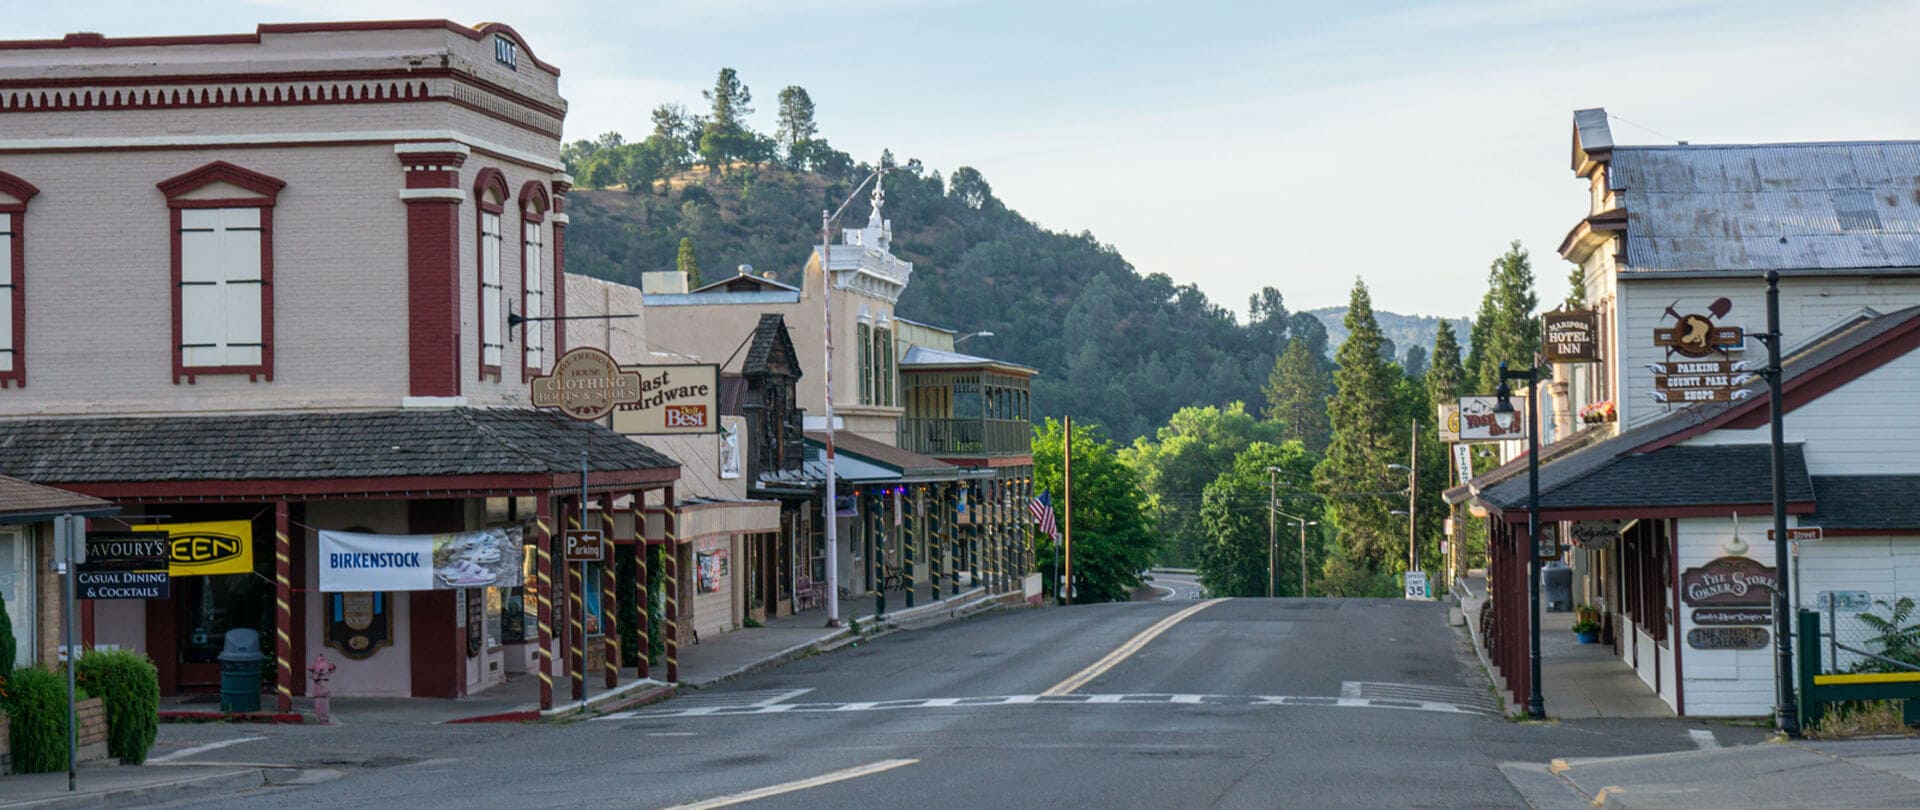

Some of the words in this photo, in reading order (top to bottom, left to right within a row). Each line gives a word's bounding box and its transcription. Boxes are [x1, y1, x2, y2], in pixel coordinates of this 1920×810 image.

[1549, 331, 1589, 342] HOTEL
[1558, 343, 1581, 354] INN
[1677, 363, 1720, 373] PARKING
[547, 377, 626, 391] CLOTHING
[642, 370, 670, 392] ast
[1667, 377, 1700, 387] COUNTY
[1705, 376, 1729, 386] PARK
[540, 391, 578, 402] BOOTS
[583, 392, 591, 401] &
[596, 389, 635, 400] SHOES
[1684, 390, 1715, 401] SHOPS
[666, 408, 705, 427] Best
[1459, 447, 1470, 485] PIZZ
[168, 537, 237, 561] EEN
[567, 536, 600, 558] Parking
[330, 551, 420, 569] BIRKENSTOCK
[79, 572, 121, 584] CASUAL
[123, 572, 166, 583] DINING
[1702, 572, 1727, 585] THE
[87, 587, 97, 597] &
[98, 586, 159, 597] COCKTAILS
[1408, 586, 1424, 596] 35
[1688, 583, 1732, 600] CORNER
